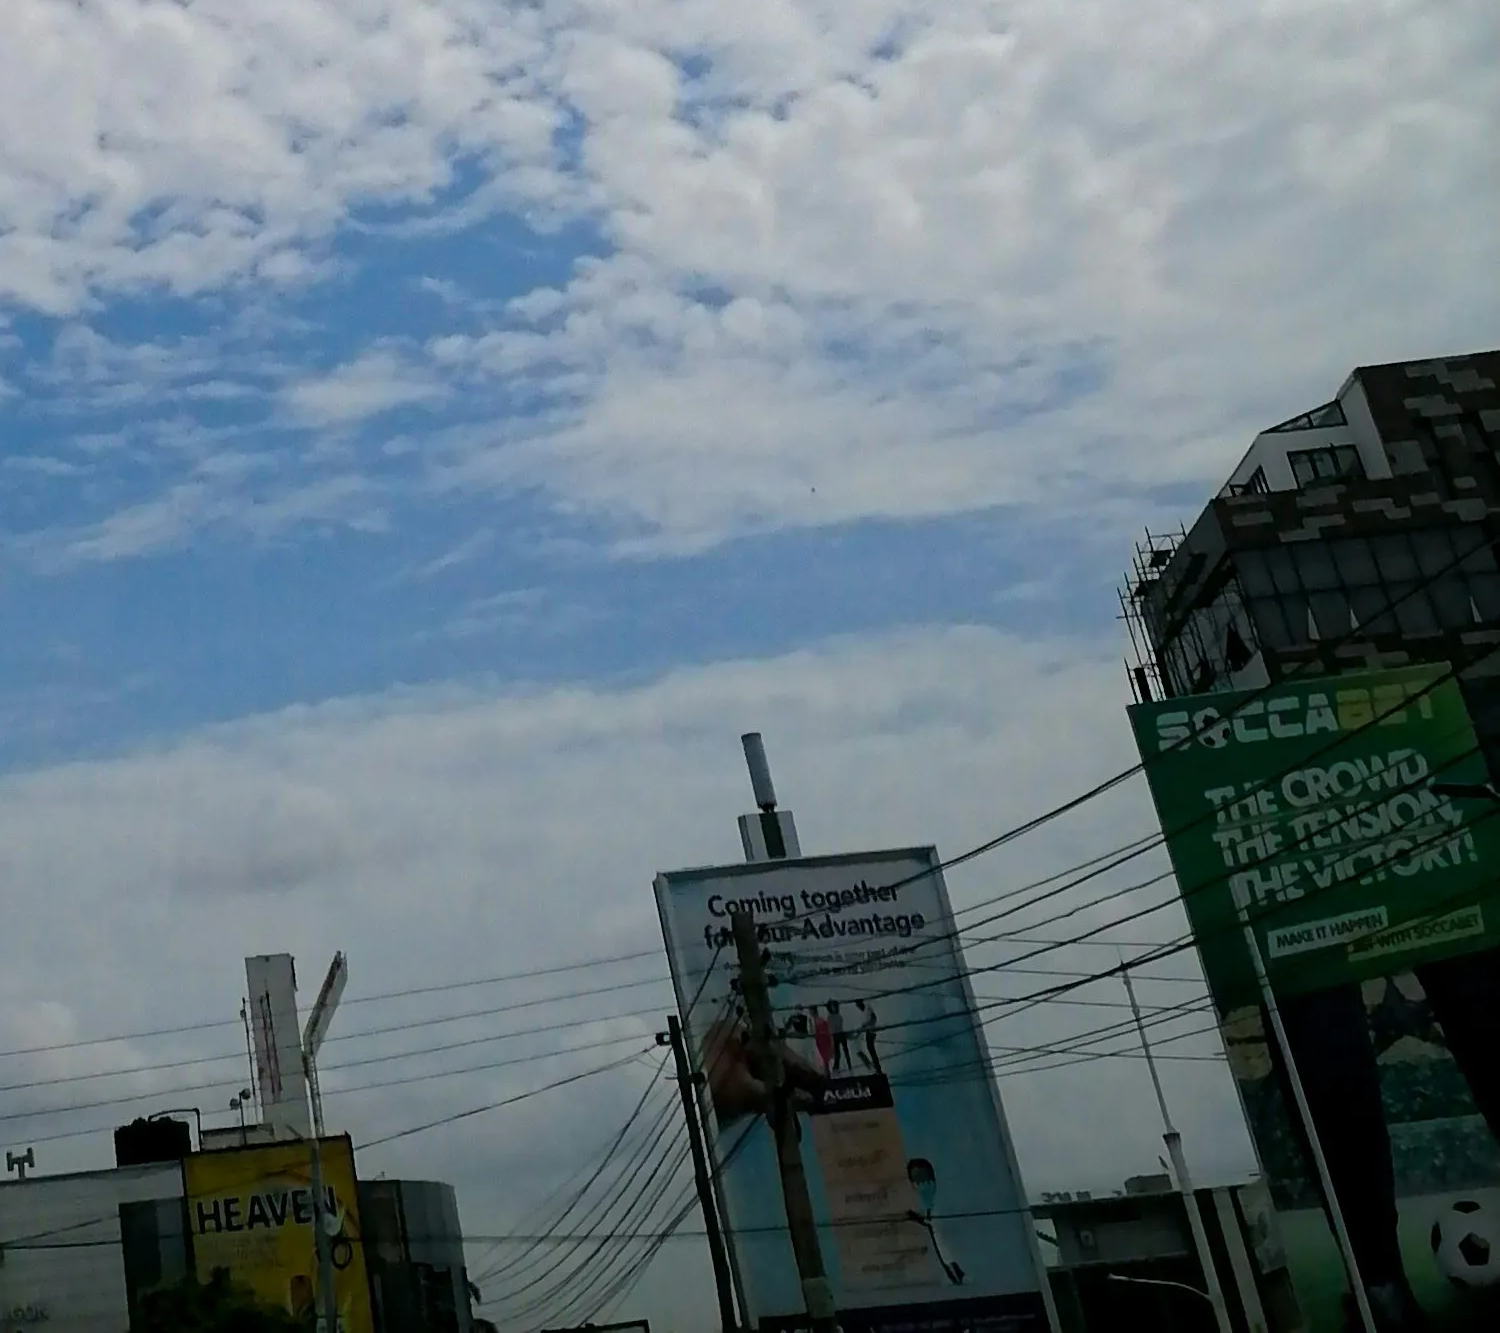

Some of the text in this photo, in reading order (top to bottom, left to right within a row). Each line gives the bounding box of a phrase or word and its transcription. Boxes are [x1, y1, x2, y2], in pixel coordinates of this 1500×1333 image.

[1204, 779, 1279, 825] THE
[1212, 819, 1283, 867] THE
[1228, 827, 1479, 909] THE VICTORY!
[708, 880, 899, 919] Coming together
[704, 923, 736, 950] for
[801, 911, 925, 938] Advantage
[1276, 913, 1384, 949] MAKE IT HAPPEN
[196, 1185, 338, 1234] HEAVEN
